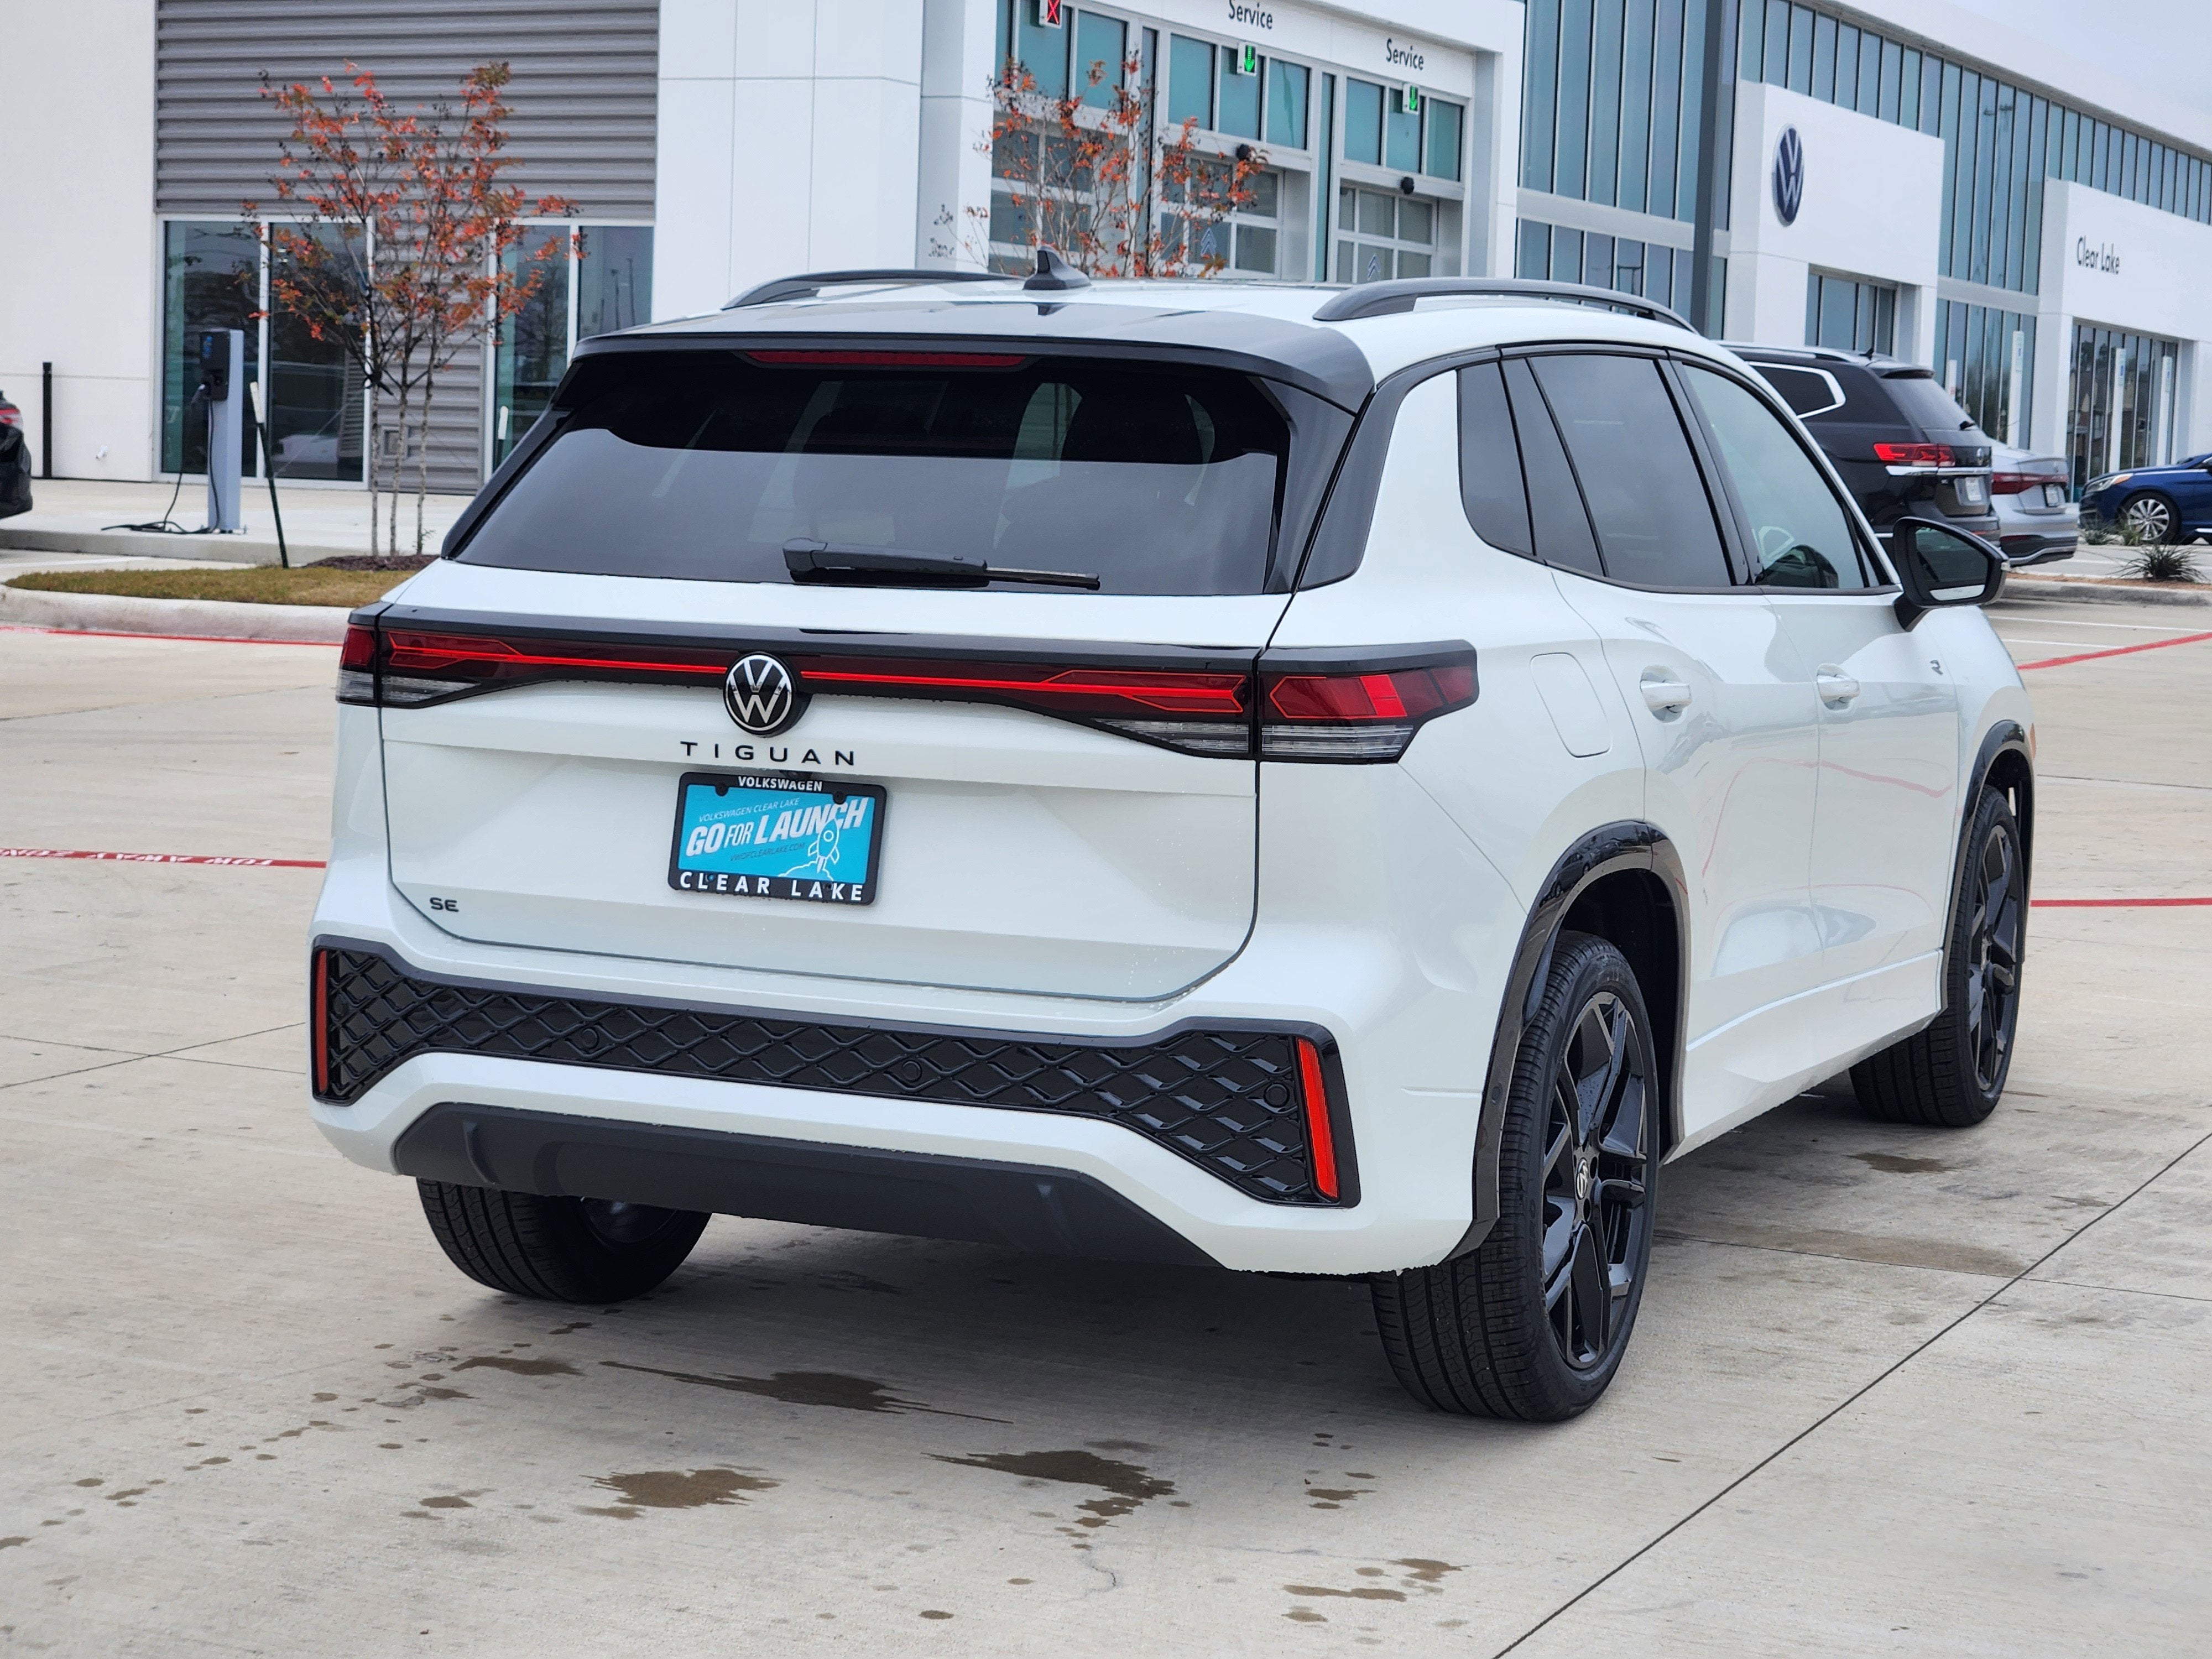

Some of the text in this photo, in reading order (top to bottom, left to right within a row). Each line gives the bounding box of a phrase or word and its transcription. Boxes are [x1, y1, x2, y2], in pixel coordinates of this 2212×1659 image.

[1228, 0, 1273, 29] Service
[1386, 38, 1424, 70] Service
[1771, 123, 1805, 226] VW
[2077, 236, 2120, 275] Clear Lake
[725, 654, 792, 732] VW
[680, 740, 854, 766] TIGUAN
[738, 776, 823, 792] VOLKSWAGEN
[699, 797, 801, 822] VOLKSWAGEN CLEAR LAKE
[686, 797, 869, 857] GO FOR LAUNCH
[0, 848, 75, 857] ZON
[85, 852, 194, 863] AWAY
[679, 872, 863, 901] CLEAR LAKE
[429, 897, 459, 912] SE
